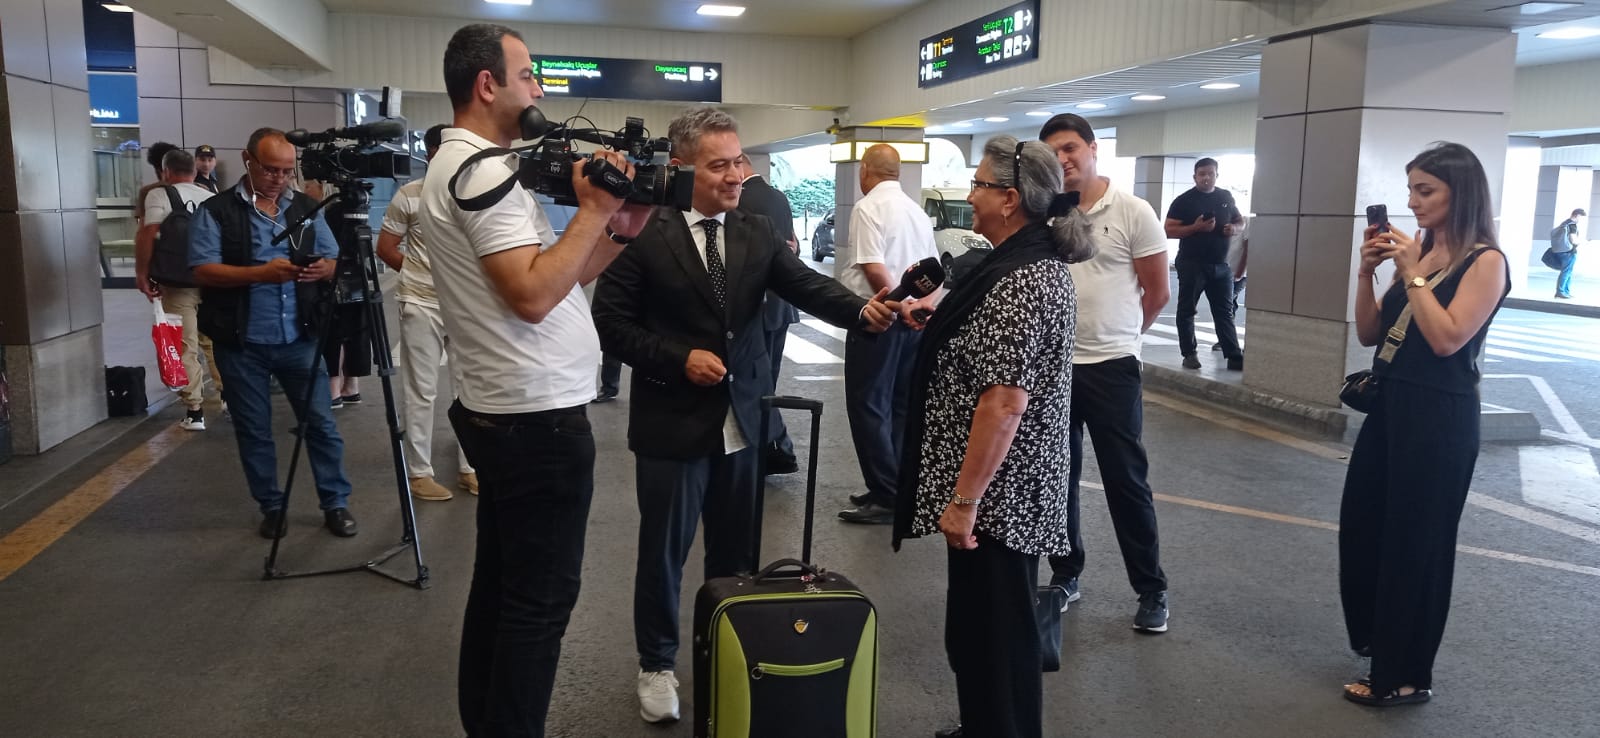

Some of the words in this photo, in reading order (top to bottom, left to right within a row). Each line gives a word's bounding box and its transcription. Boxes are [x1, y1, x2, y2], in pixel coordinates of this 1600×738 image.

[1003, 16, 1014, 34] T2
[933, 42, 941, 57] T1
[542, 77, 568, 85] Terminal
